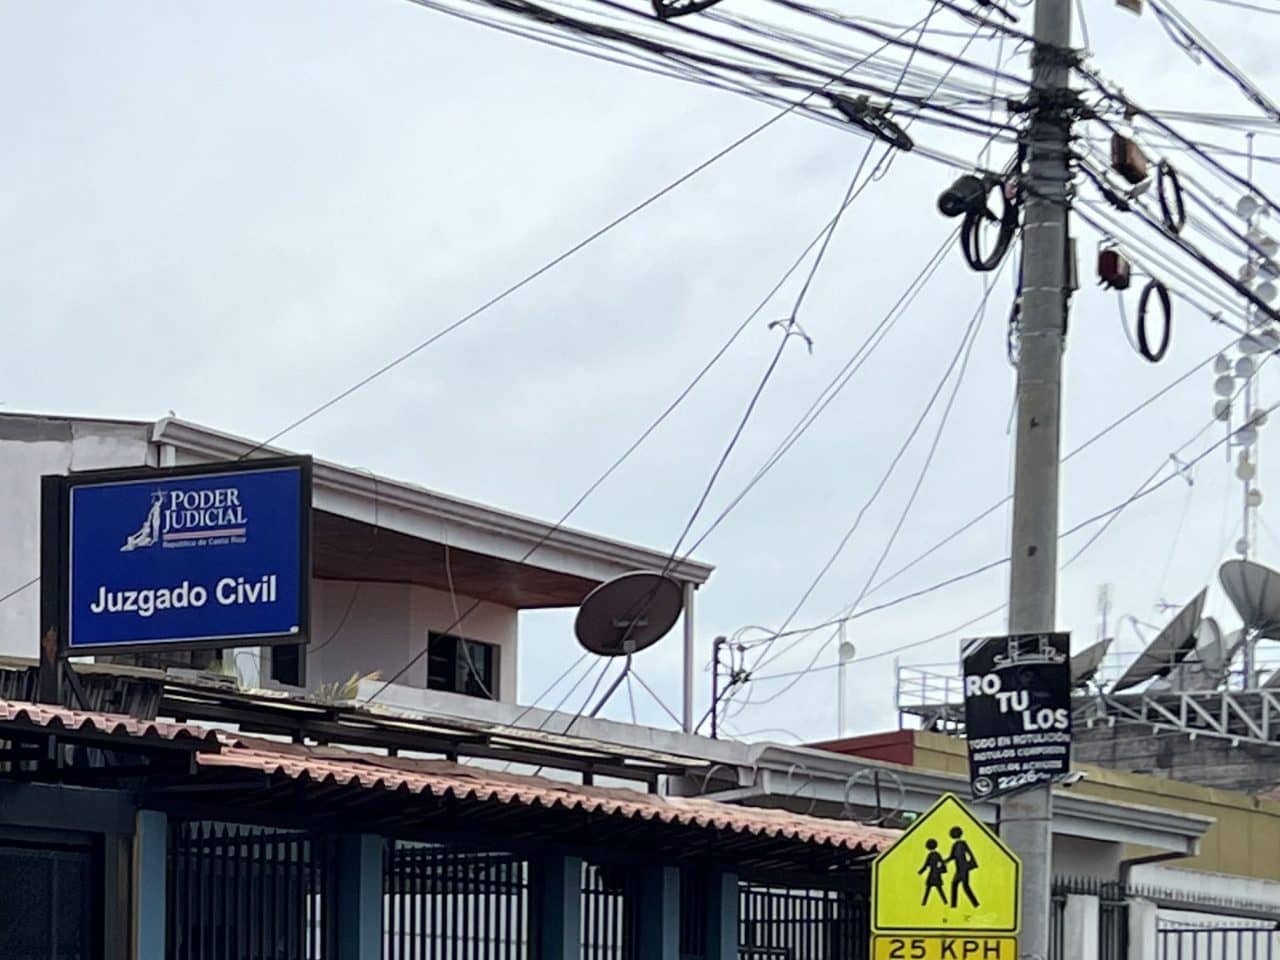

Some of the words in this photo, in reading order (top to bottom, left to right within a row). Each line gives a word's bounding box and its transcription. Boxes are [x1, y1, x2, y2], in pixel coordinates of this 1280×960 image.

[170, 488, 241, 511] PODER
[162, 506, 248, 533] JUDICIAL
[90, 580, 207, 617] Juzgado
[216, 574, 277, 606] Civil
[965, 673, 1001, 697] RO
[995, 690, 1029, 713] TU
[1023, 708, 1069, 731] LOS
[968, 737, 996, 750] TODO
[997, 735, 1011, 746] EN
[888, 939, 926, 960] 25
[941, 939, 1001, 960] KPH
